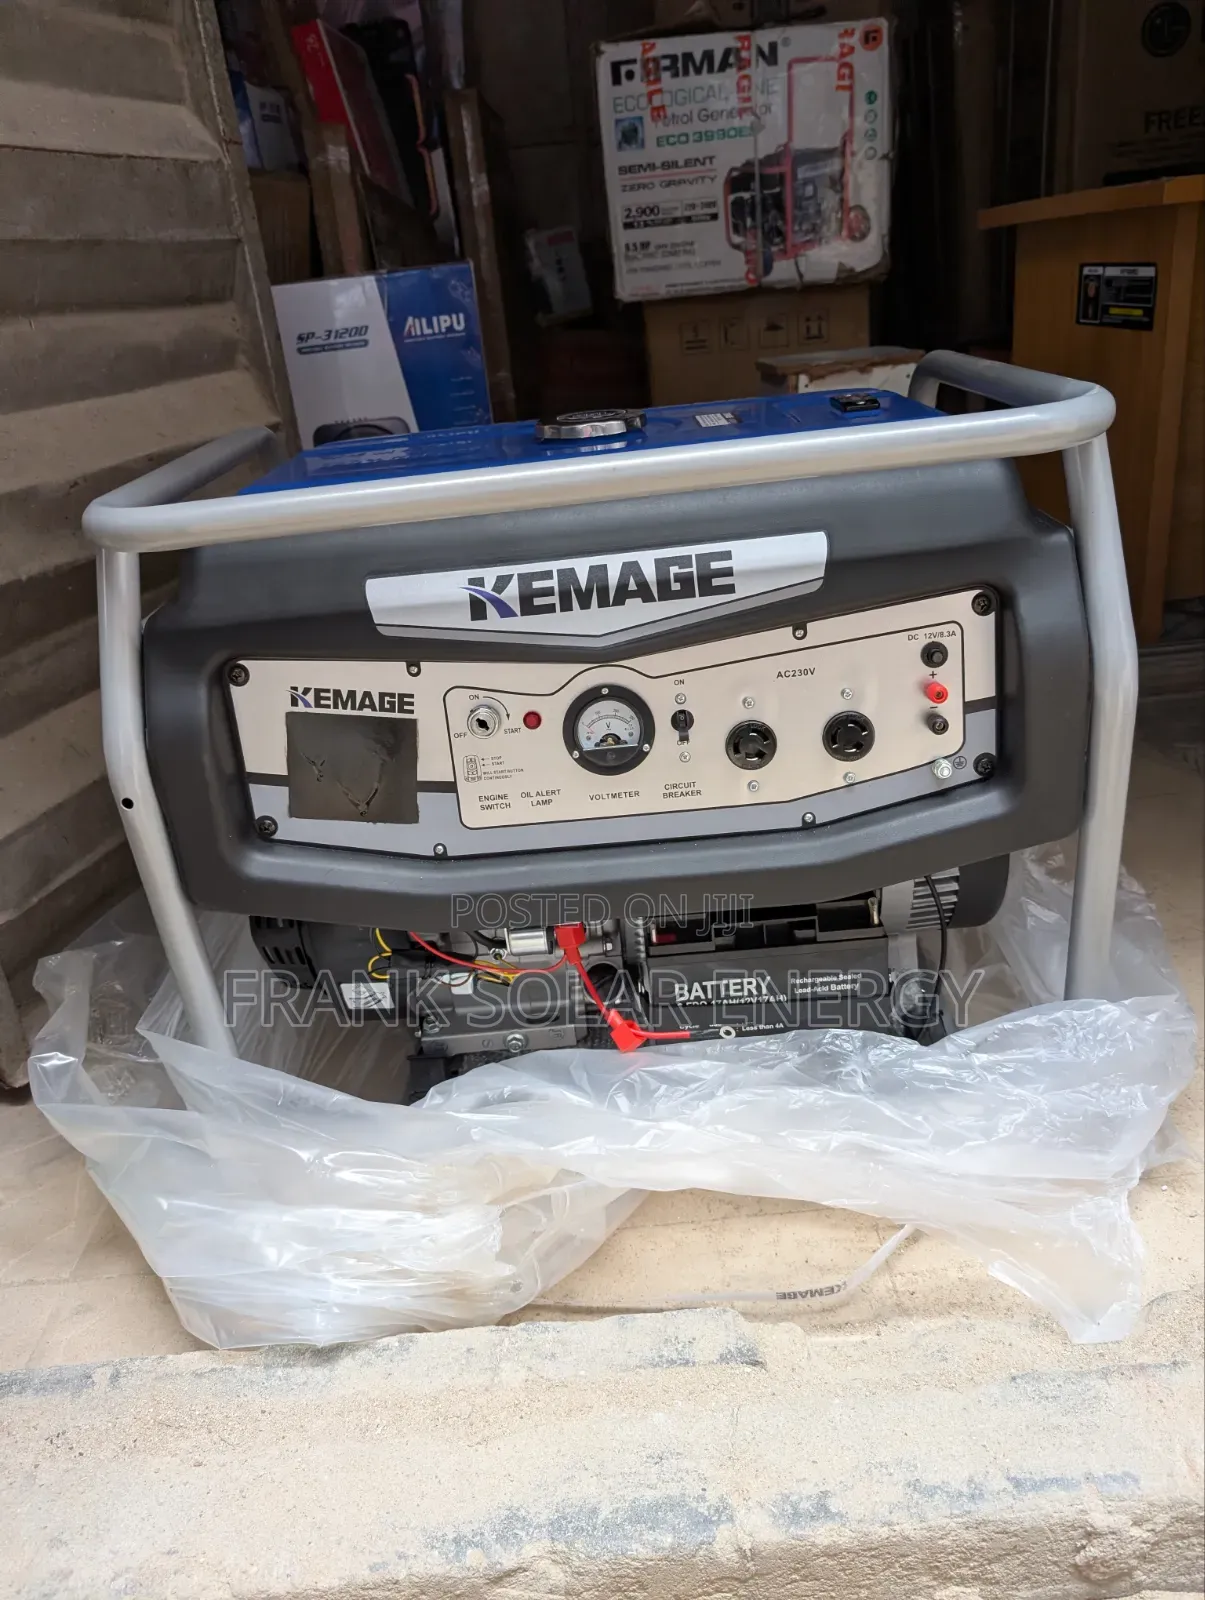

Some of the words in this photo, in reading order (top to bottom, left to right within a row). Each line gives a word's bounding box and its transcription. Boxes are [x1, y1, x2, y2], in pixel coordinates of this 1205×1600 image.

[1144, 106, 1205, 134] FREE
[656, 132, 690, 148] ECO
[618, 155, 716, 176] SEMI-SILENT
[621, 181, 655, 193] ZERO
[659, 174, 718, 190] GRAVITY
[403, 312, 466, 338] AILIPU
[296, 325, 369, 346] SP-31200
[460, 550, 737, 622] KEMAGE
[924, 631, 957, 640] 12V/8.3A
[776, 667, 816, 679] AC230V
[285, 685, 415, 714] KEMAGE
[503, 727, 522, 735] START
[664, 781, 697, 791] CIRCUIT
[478, 793, 509, 802] ENGINE
[520, 791, 534, 799] OIL
[535, 789, 562, 797] ALERT
[588, 790, 640, 801] VOLTMETER
[662, 789, 702, 799] BREAKER
[480, 802, 511, 811] SWITCH
[531, 798, 553, 807] LAMP
[790, 974, 838, 984] Rechargeable
[838, 972, 862, 981] Sealed
[674, 976, 771, 1002] BATTERY
[830, 983, 860, 991] Battery
[741, 1024, 758, 1032] Less
[758, 1023, 774, 1031] than
